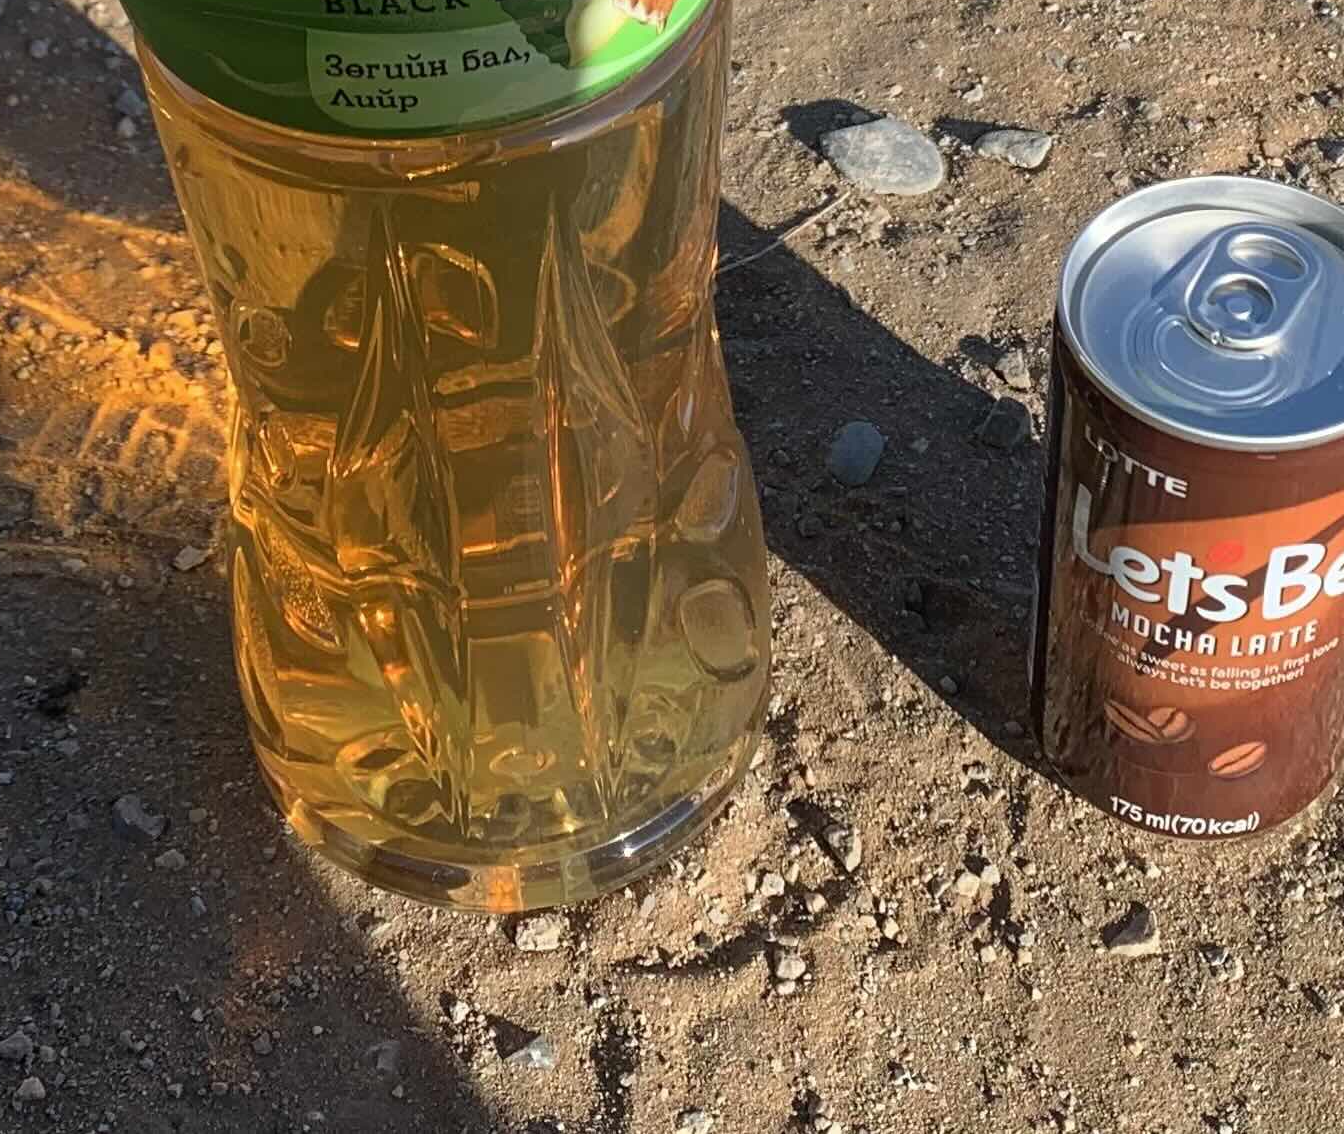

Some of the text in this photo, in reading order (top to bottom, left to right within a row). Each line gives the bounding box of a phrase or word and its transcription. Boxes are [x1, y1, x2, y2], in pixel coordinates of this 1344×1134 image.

[324, 47, 531, 82] Зөгийн бал,
[328, 87, 419, 114] Лийр
[1085, 425, 1189, 499] LOTTE
[1110, 600, 1320, 657] MOCHA LATTE
[1140, 650, 1187, 676] sweet
[1190, 666, 1207, 678] as
[1211, 663, 1261, 681] falling
[1264, 662, 1279, 675] in
[1283, 652, 1311, 672] first
[1312, 636, 1340, 660] love
[1209, 676, 1231, 690] be
[1109, 795, 1144, 824] 175
